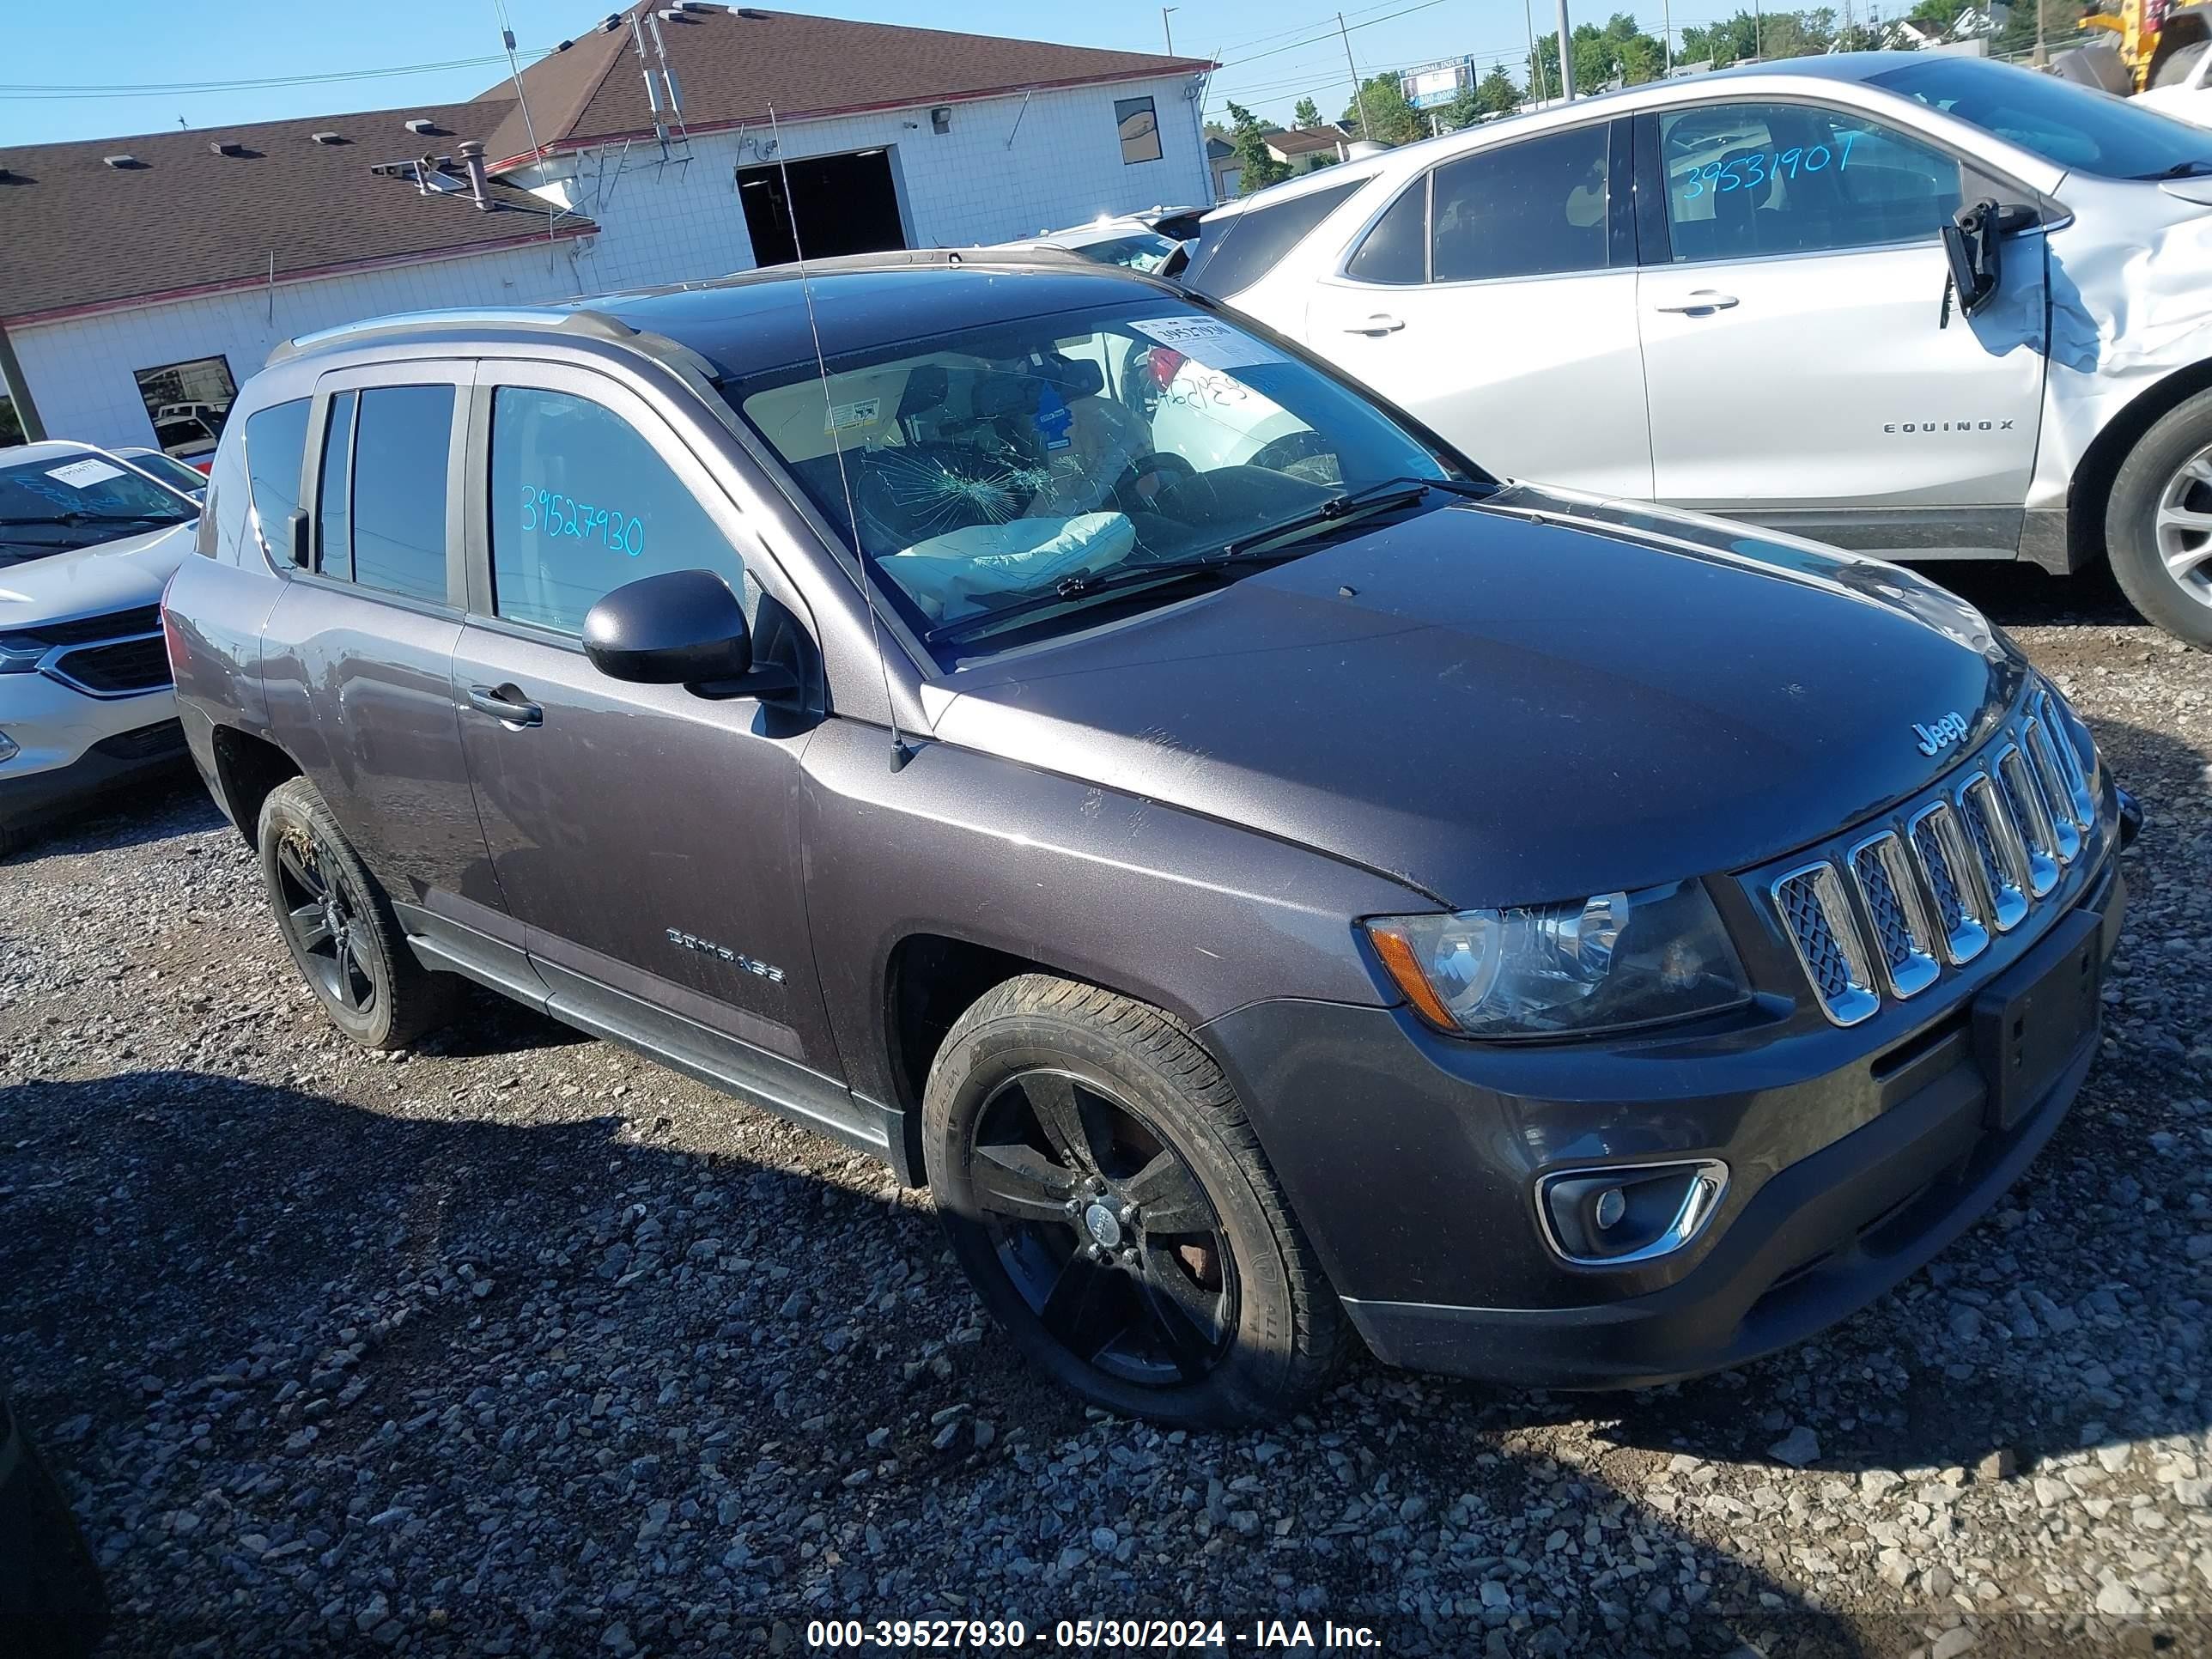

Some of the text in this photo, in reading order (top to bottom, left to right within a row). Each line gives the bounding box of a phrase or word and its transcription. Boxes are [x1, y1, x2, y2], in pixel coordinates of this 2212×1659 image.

[1405, 57, 1465, 76] PERSONAL INJURY
[1684, 136, 1854, 198] 39531901
[1157, 325, 1231, 341] 39527930
[1883, 419, 2014, 434] EQUINOX
[522, 485, 644, 556] 39527930
[1911, 711, 1969, 756] Jeep
[665, 927, 787, 984] COMPASS
